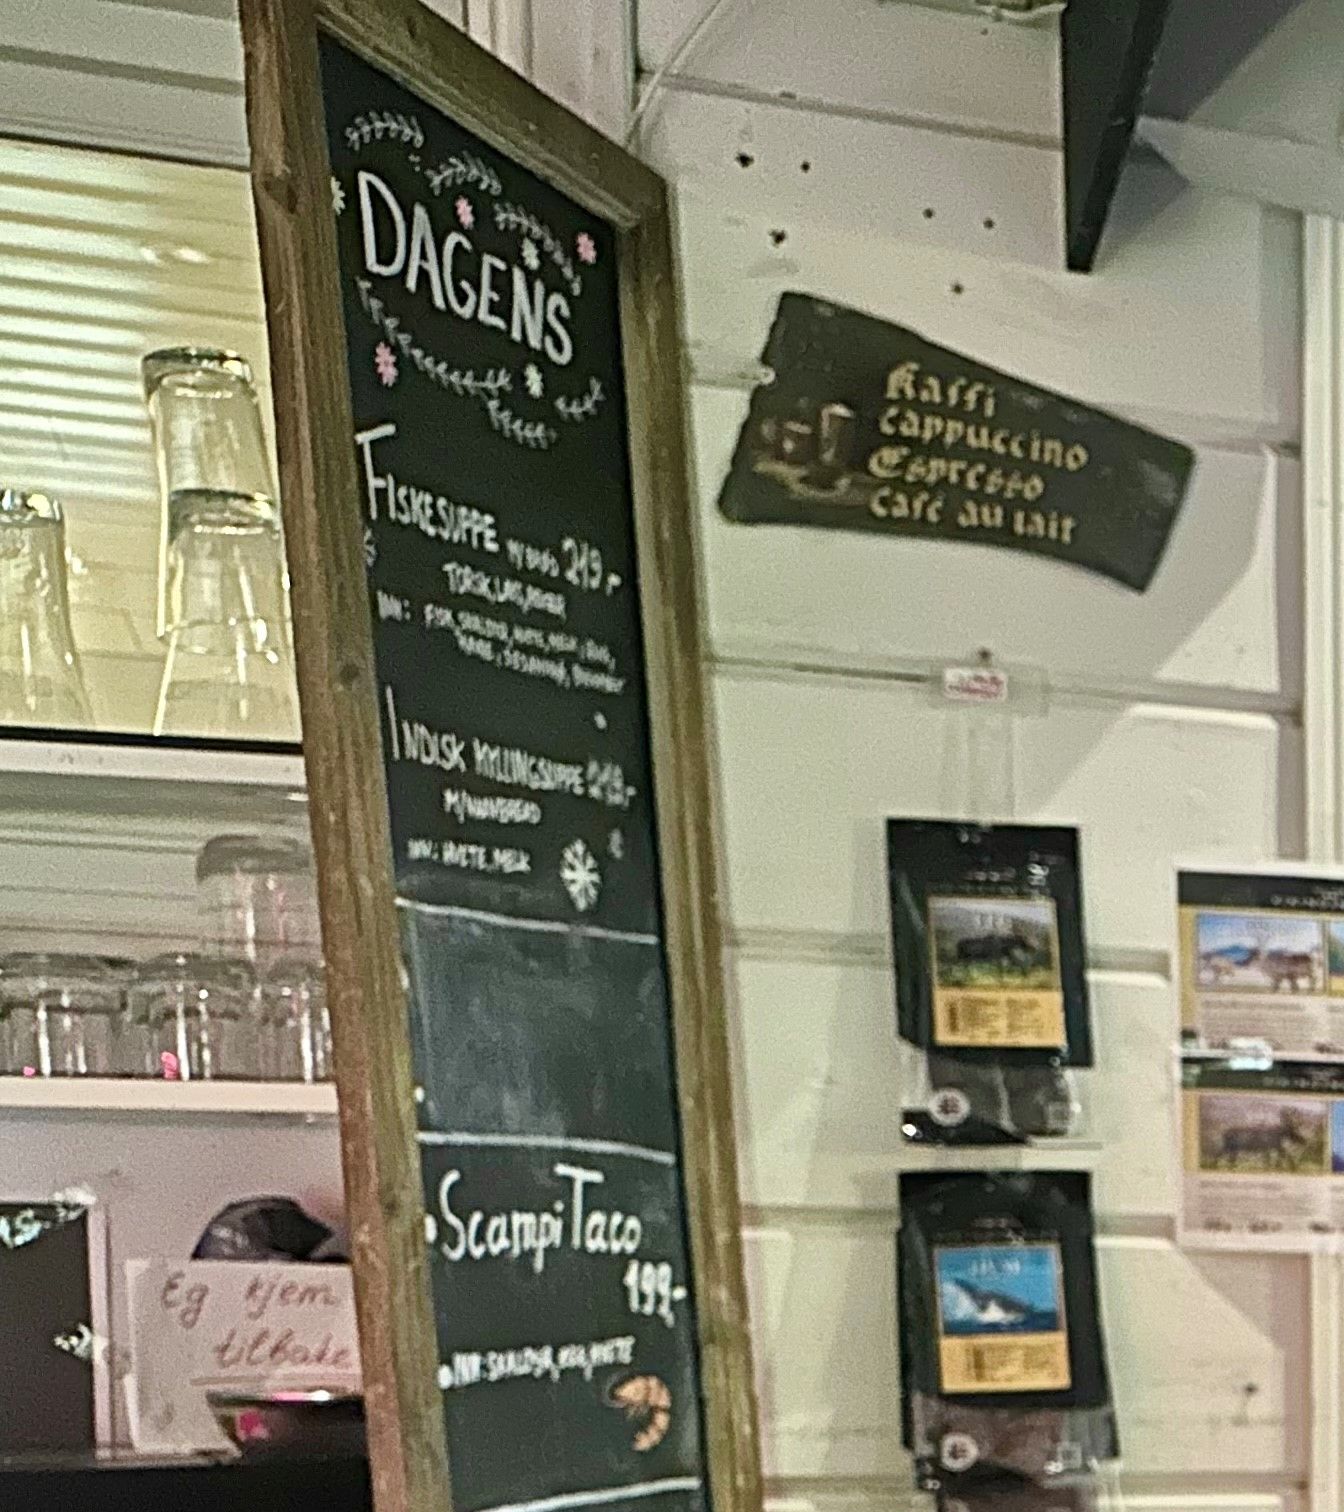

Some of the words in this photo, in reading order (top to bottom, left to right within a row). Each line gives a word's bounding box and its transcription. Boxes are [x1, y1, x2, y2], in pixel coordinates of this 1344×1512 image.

[358, 170, 573, 366] DAGENS
[355, 424, 499, 552] FISKESUPPE
[868, 445, 1045, 501] Espresso
[958, 500, 1004, 527] au
[386, 685, 466, 773] INDISK
[473, 737, 585, 796] KYLLINGSUPPE
[439, 1168, 563, 1274] Scampi
[554, 1162, 642, 1254] Taco
[161, 1270, 209, 1330] Eg
